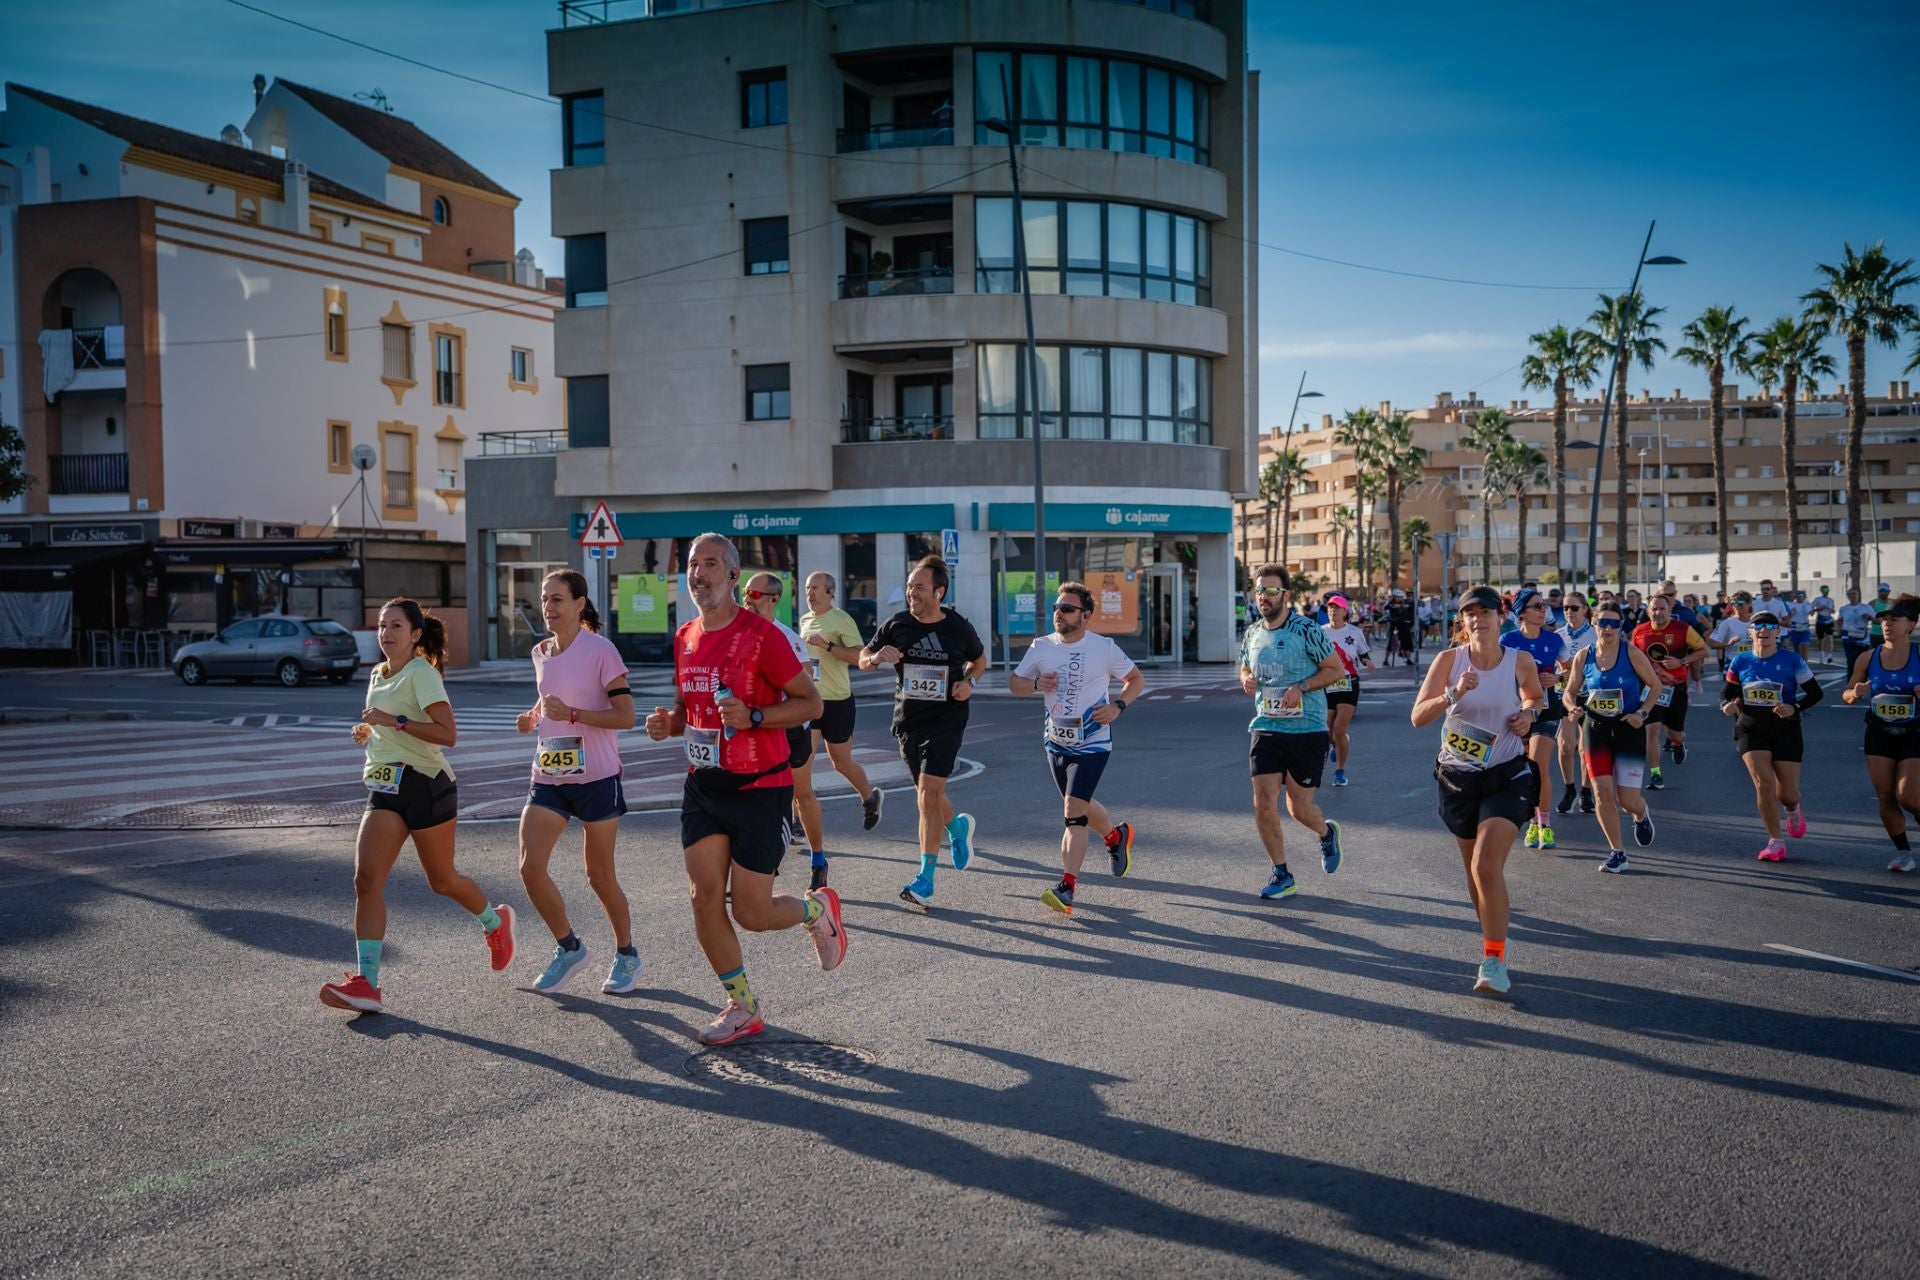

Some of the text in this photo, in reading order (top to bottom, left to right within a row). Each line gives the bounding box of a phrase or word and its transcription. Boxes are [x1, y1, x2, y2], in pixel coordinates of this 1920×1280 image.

[751, 514, 802, 530] cajamar
[1125, 510, 1170, 525] cajamar
[908, 648, 949, 660] adidas
[681, 679, 710, 692] MÁLAGA
[911, 680, 937, 691] 342
[1064, 652, 1081, 716] MARATON
[1750, 690, 1775, 699] 182
[1267, 699, 1280, 709] 12
[1591, 700, 1616, 709] 155
[1879, 705, 1907, 715] 158
[1448, 733, 1481, 757] 232
[541, 752, 574, 766] 245
[689, 744, 711, 761] 632
[368, 767, 392, 782] 58
